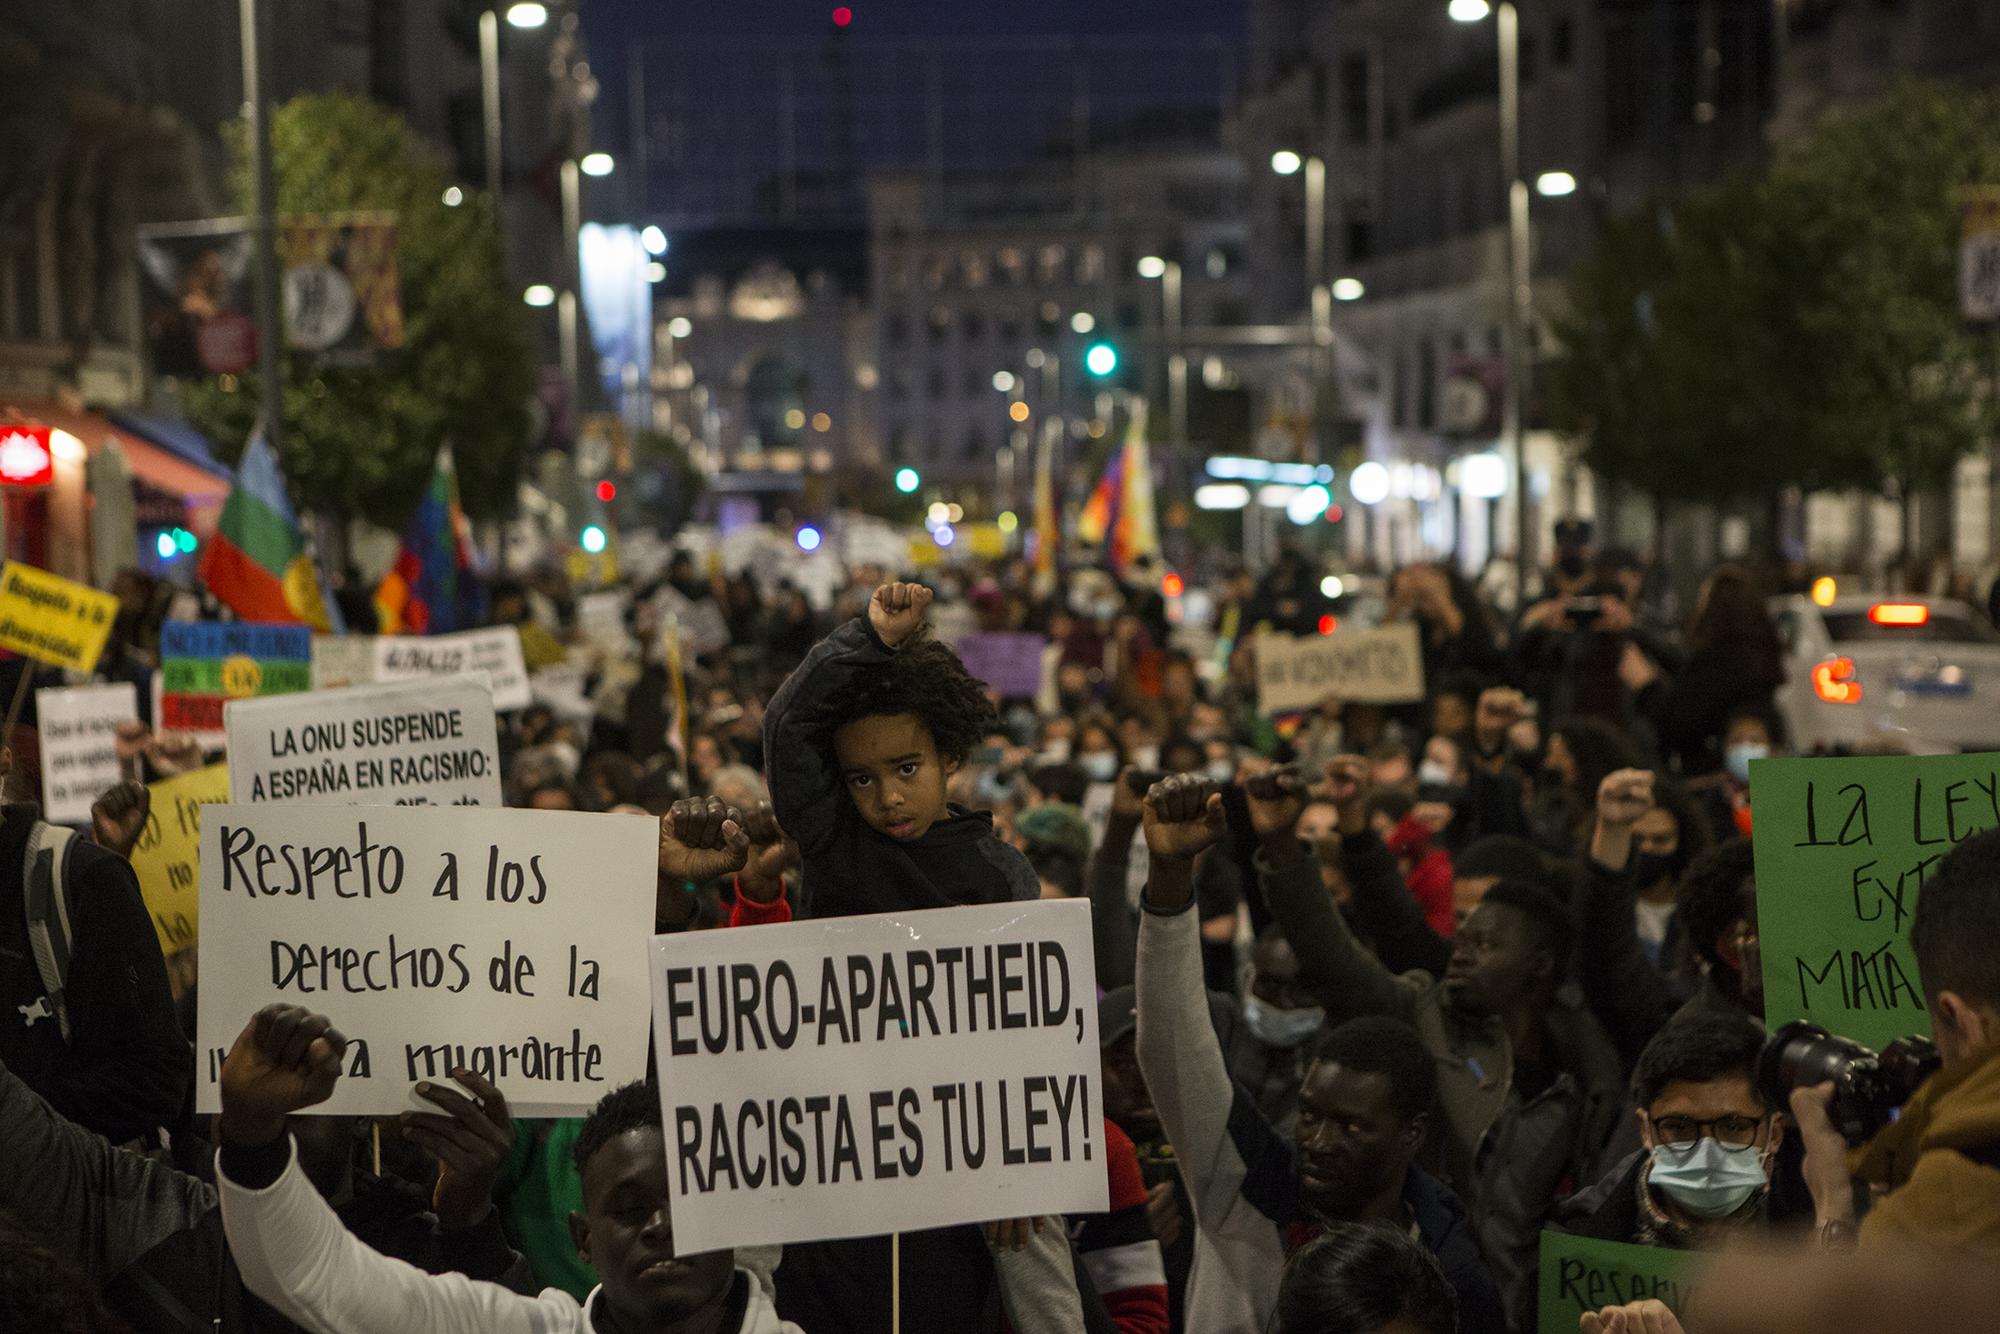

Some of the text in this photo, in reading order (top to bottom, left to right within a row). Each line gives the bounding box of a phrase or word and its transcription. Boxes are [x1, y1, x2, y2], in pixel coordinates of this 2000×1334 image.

[270, 709, 463, 758] LA ONU SUSPENDE
[252, 749, 492, 802] A ESPAÑA EN RACISMO:
[220, 822, 404, 901] Respeto
[433, 852, 459, 900] a
[486, 845, 547, 904] los
[1853, 854, 1942, 933] EXT
[271, 934, 600, 1001] Derechos de la
[666, 940, 1085, 1057] EURO-APARTHEID,
[405, 1028, 605, 1088] migrante
[675, 1074, 1092, 1196] RACISTA ES TU LEY!
